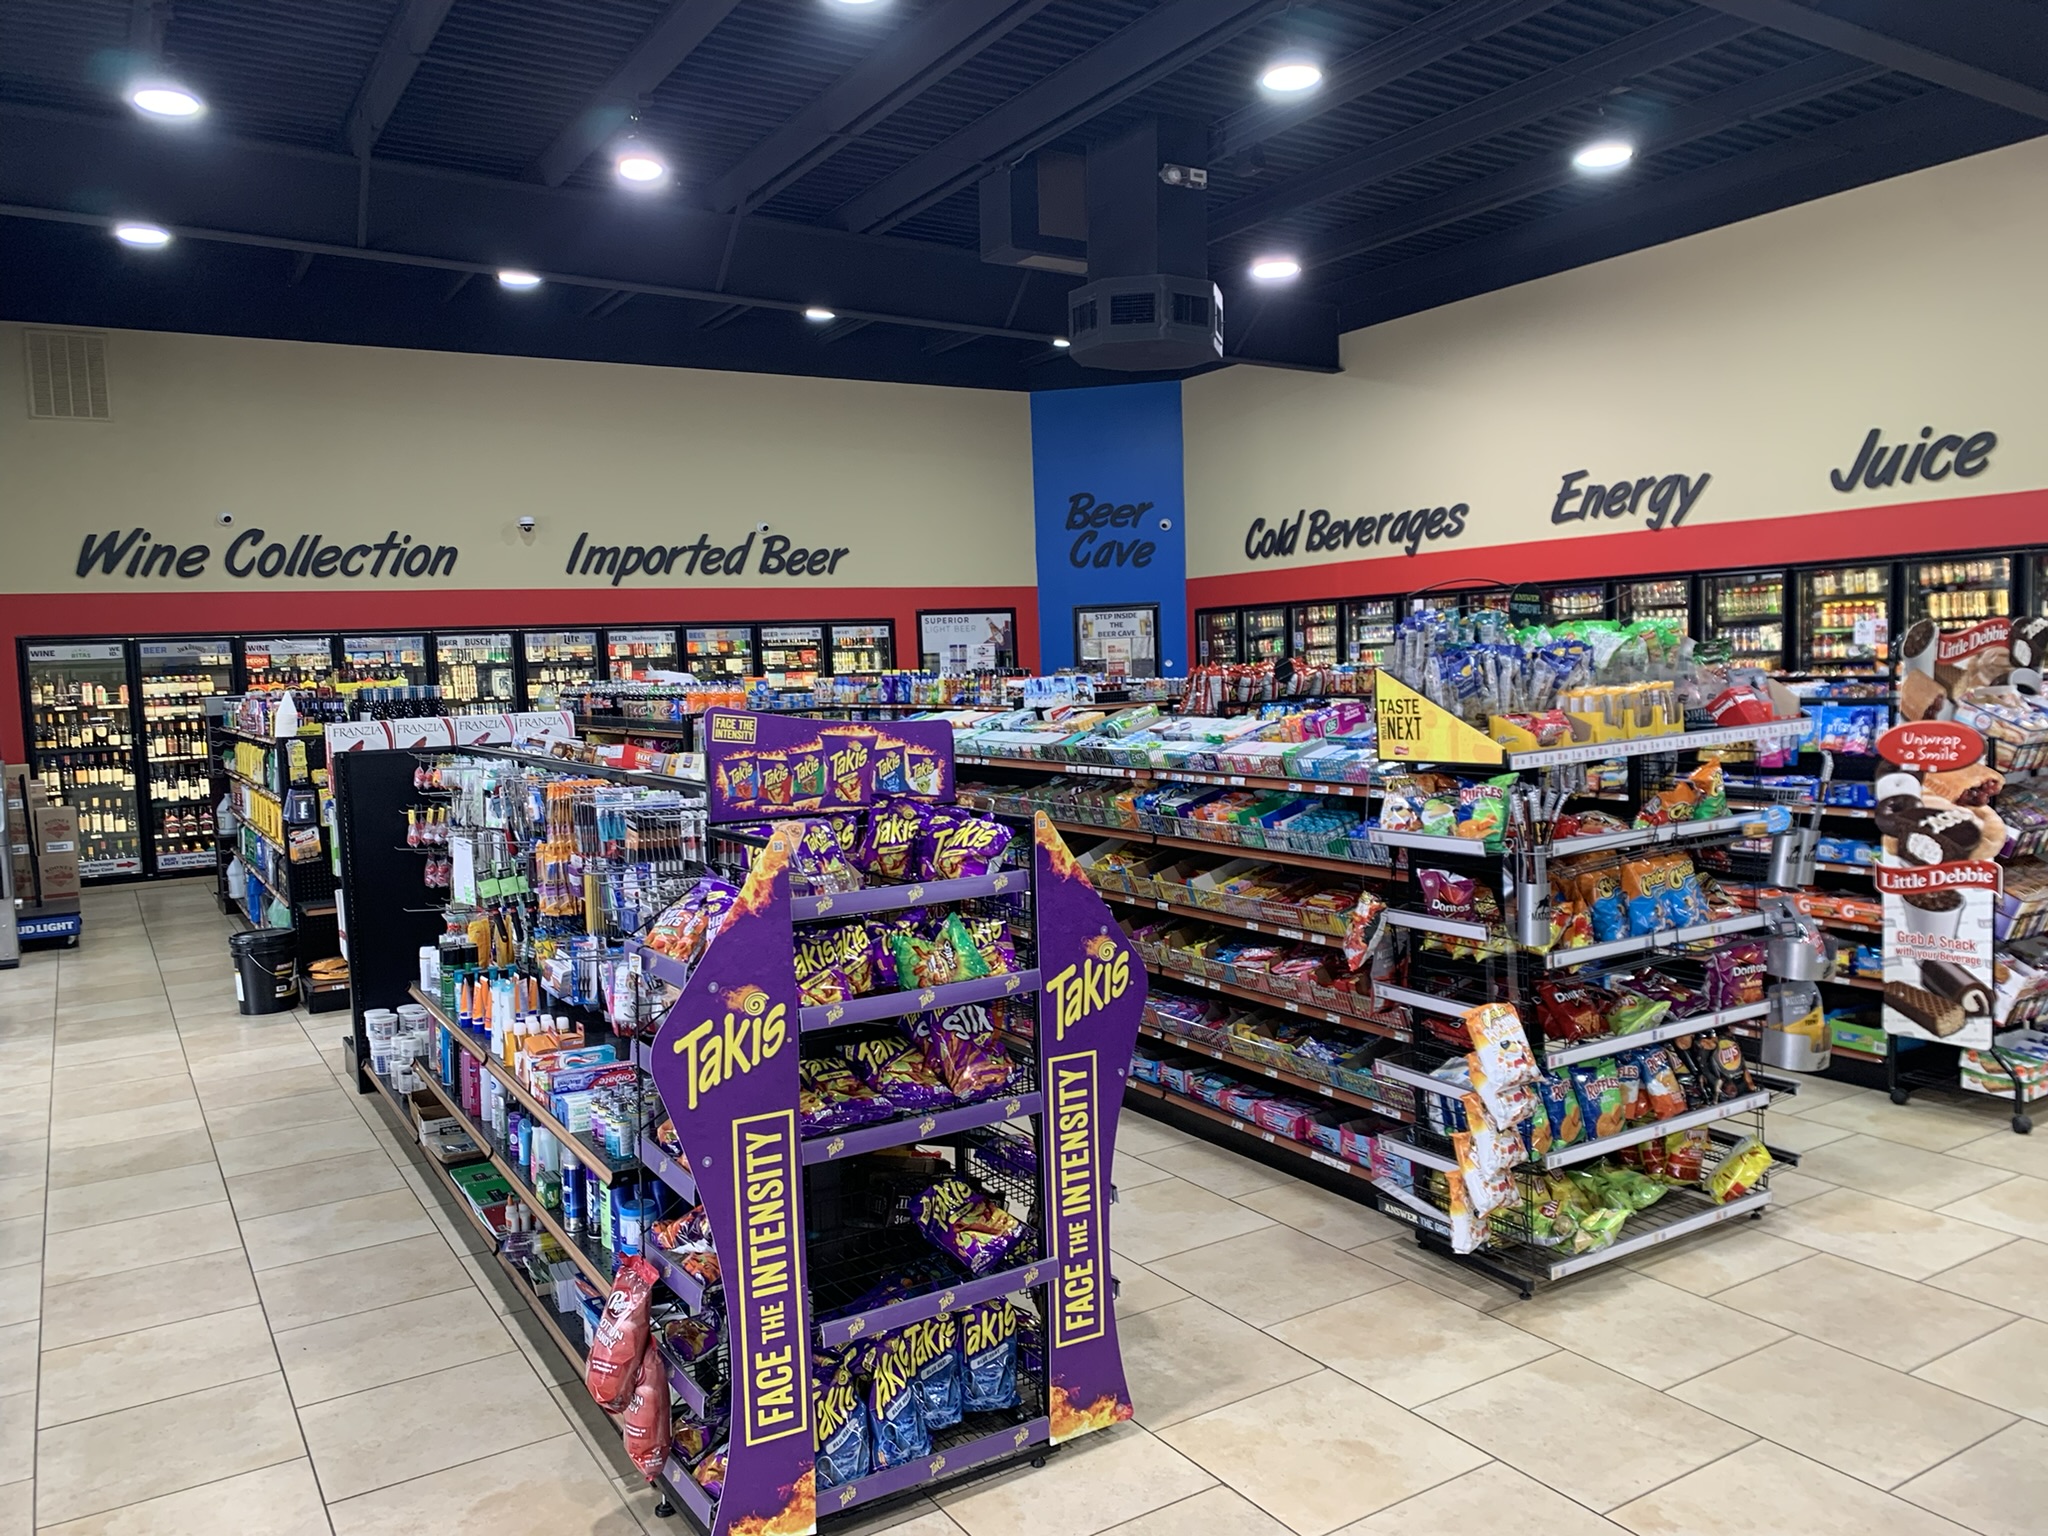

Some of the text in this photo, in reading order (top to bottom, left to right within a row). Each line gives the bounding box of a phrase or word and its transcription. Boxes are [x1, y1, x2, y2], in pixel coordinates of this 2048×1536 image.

[1830, 425, 1997, 493] Juice
[1065, 490, 1154, 532] Beer
[1551, 469, 1711, 532] Energy
[1245, 503, 1470, 560] Cold Beverages
[75, 527, 459, 579] Wine Collection
[565, 531, 850, 586] Imported Beer
[1069, 530, 1156, 568] Cave
[924, 616, 970, 625] SUPERIOR
[925, 624, 977, 633] LIGHT BEER
[143, 646, 167, 654] BEER
[464, 637, 491, 646] BUSCH
[1939, 625, 2008, 658] Little Debbie
[1380, 699, 1420, 715] TASTE
[333, 726, 383, 738] FRANZIA
[397, 722, 445, 735] FRANZIA
[459, 719, 507, 733] FRANZIA
[519, 716, 564, 729] FRANZIA
[716, 718, 755, 731] FACE THE
[1387, 717, 1421, 740] NEXT
[715, 729, 754, 741] INTENSITY
[1902, 732, 1962, 749] Unwrap
[830, 748, 868, 780] Takis
[1905, 749, 1959, 761] a Smile
[729, 761, 754, 787] Takis
[762, 766, 789, 789] Takis
[794, 756, 819, 782] Takis
[876, 755, 900, 779] Takis
[911, 762, 935, 783] Takis
[1460, 786, 1503, 803] RUFFLES
[875, 814, 919, 848] Takis
[934, 820, 998, 868] Takis
[993, 874, 1009, 893] Takis
[1882, 867, 1994, 889] Little Debbie
[907, 885, 925, 904] Takis
[816, 896, 833, 915] Takis
[1431, 899, 1471, 913] Doritos
[18, 921, 74, 935] UD LIGHT
[835, 924, 869, 964] akis
[1897, 931, 1976, 951] Grab A Snack
[794, 938, 835, 980] akis
[1895, 947, 1982, 966] with your Beverage
[1733, 963, 1768, 977] Doritos
[1005, 976, 1021, 994] Takis
[918, 991, 936, 1009] Takis
[1046, 950, 1130, 1042] Takis
[826, 1006, 844, 1026] Takis
[942, 1003, 993, 1041] STIX
[673, 1002, 786, 1110] Takis
[1719, 1044, 1739, 1065] Lay's
[598, 1073, 637, 1085] Colgate
[1617, 1065, 1639, 1079] FLES
[1586, 1077, 1620, 1101] RUFFLES
[1005, 1101, 1021, 1120] Takis
[919, 1119, 936, 1138] Takis
[826, 1139, 845, 1159] Takis
[1058, 1069, 1095, 1332] FACE THE INTENSITY
[1385, 1202, 1451, 1236] ANSWER THE GRO
[745, 1132, 794, 1427] FACE THE INTENSITY
[1023, 1267, 1039, 1287] Takis
[939, 1292, 955, 1312] Takis
[600, 1318, 624, 1341] OTTON
[848, 1319, 865, 1340] Takis
[962, 1300, 1017, 1364] Takis
[904, 1314, 956, 1377] Takis
[1014, 1428, 1030, 1449] Takis
[929, 1456, 946, 1477] Takis
[839, 1486, 857, 1508] Takis
